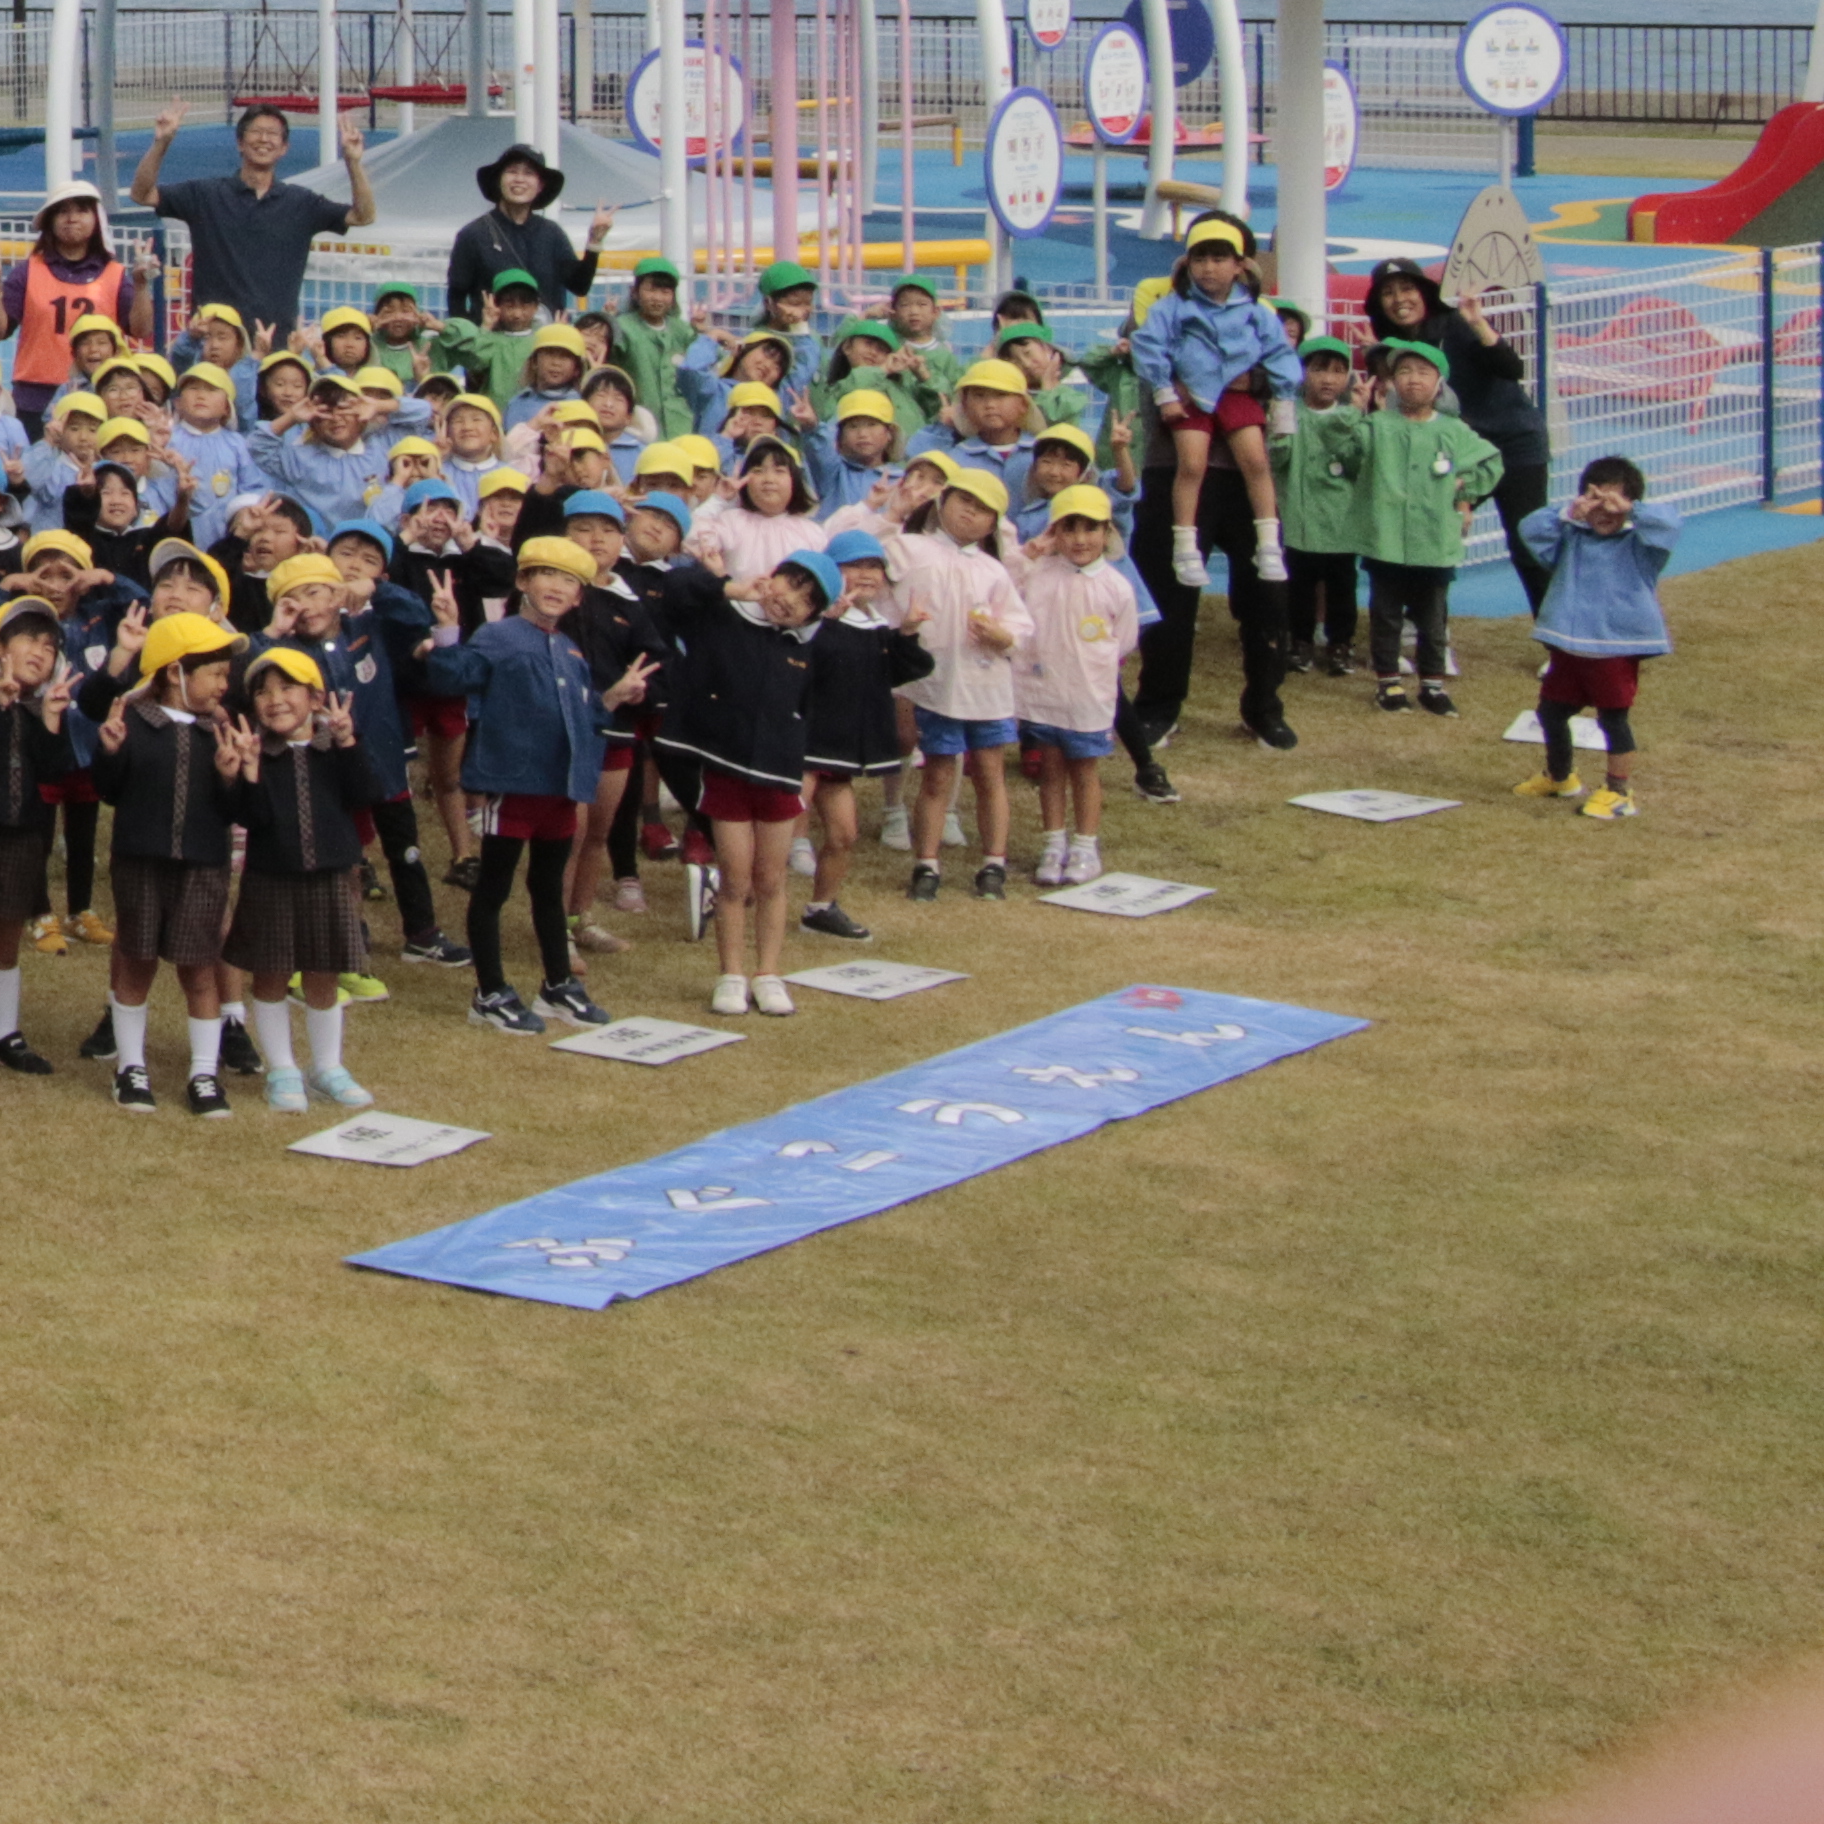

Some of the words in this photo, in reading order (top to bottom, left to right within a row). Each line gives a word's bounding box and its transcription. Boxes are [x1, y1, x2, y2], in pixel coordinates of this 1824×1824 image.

[506, 1022, 1246, 1267] ふぐこうえん
